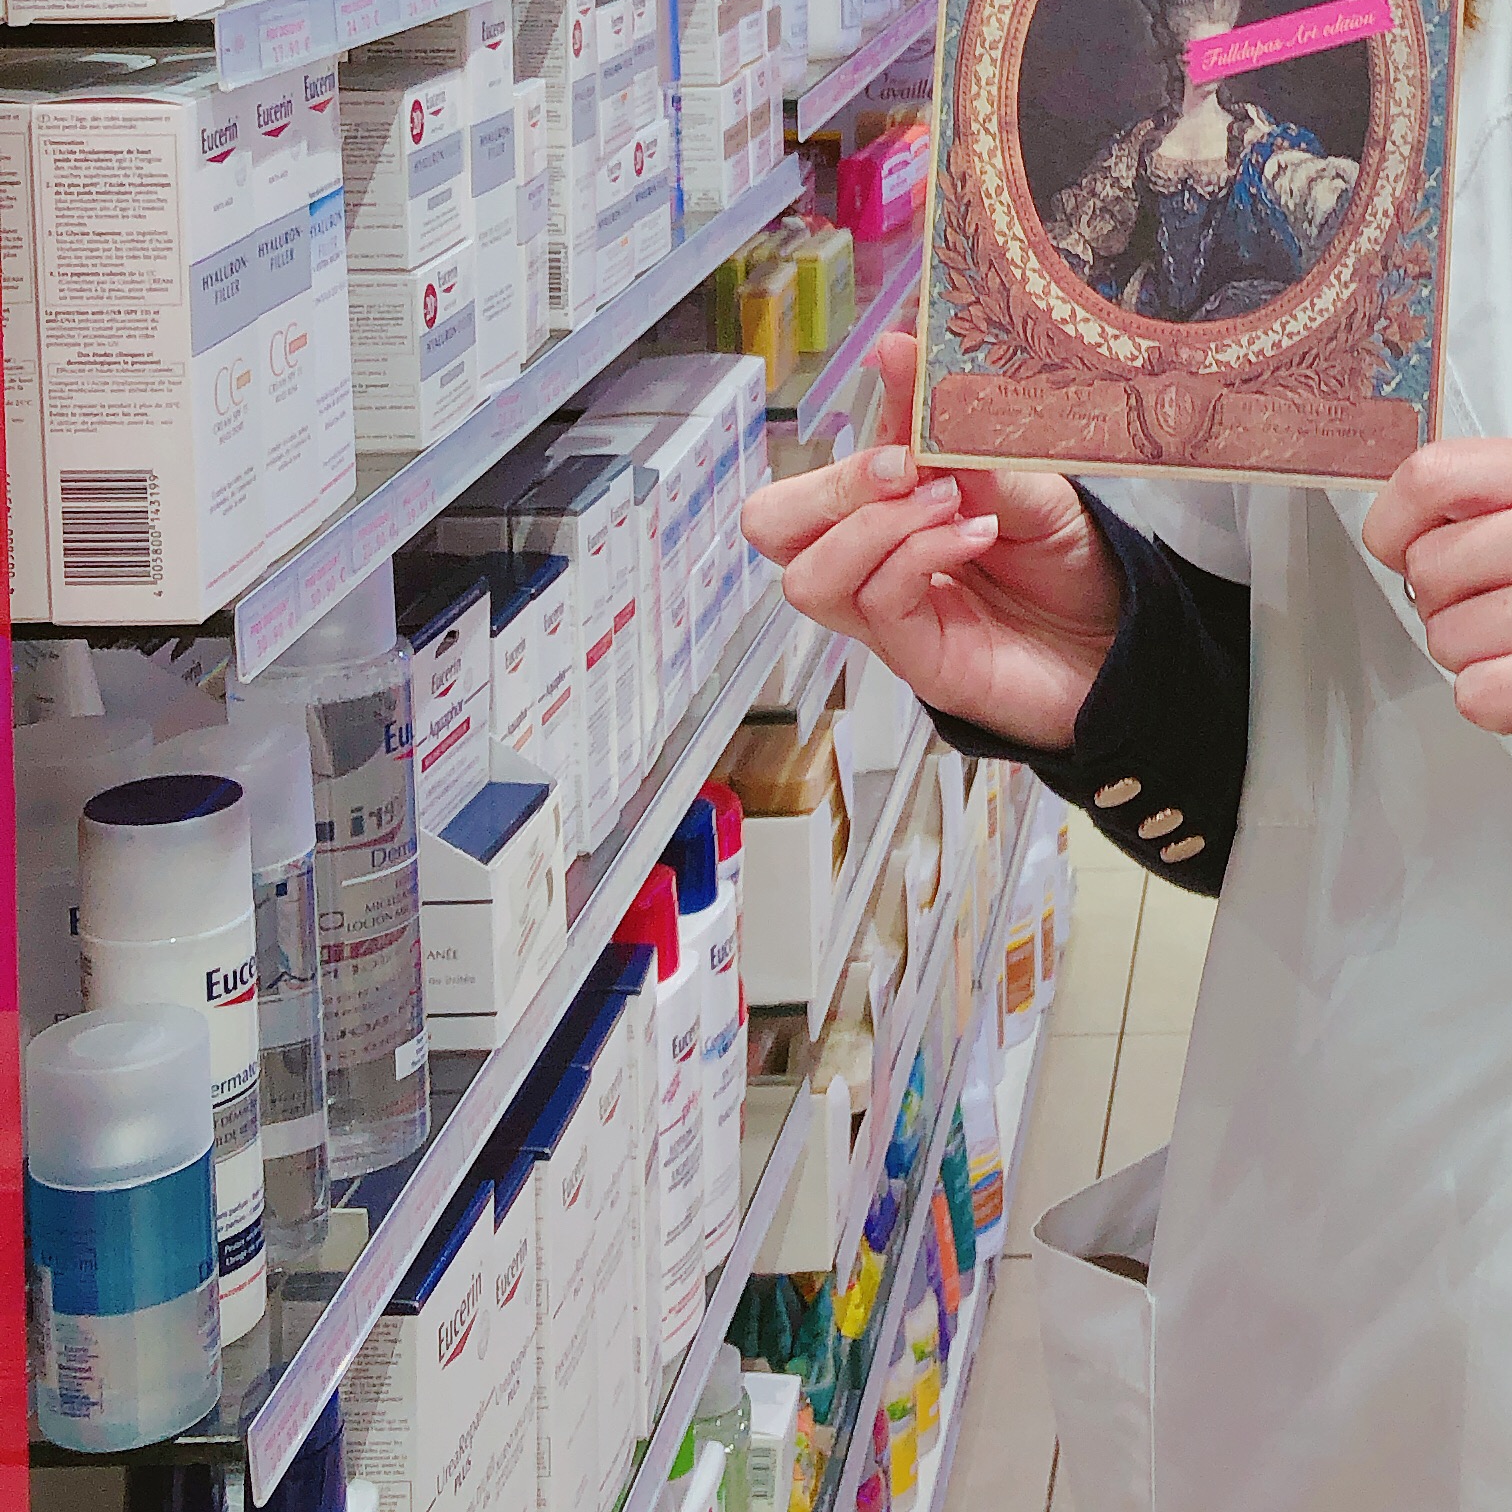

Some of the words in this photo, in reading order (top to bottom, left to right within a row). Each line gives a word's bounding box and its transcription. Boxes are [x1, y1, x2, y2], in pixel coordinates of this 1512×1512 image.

[1286, 24, 1318, 48] Art
[1322, 12, 1376, 38] edition
[304, 66, 336, 102] Eucerin
[256, 94, 293, 129] Eucerin
[201, 118, 239, 155] Eucerin
[269, 247, 295, 273] FILLER
[213, 279, 241, 306] FILLER
[205, 955, 257, 1002] Euce
[496, 1236, 528, 1308] Eucerin
[438, 1270, 483, 1365] Eucerin
